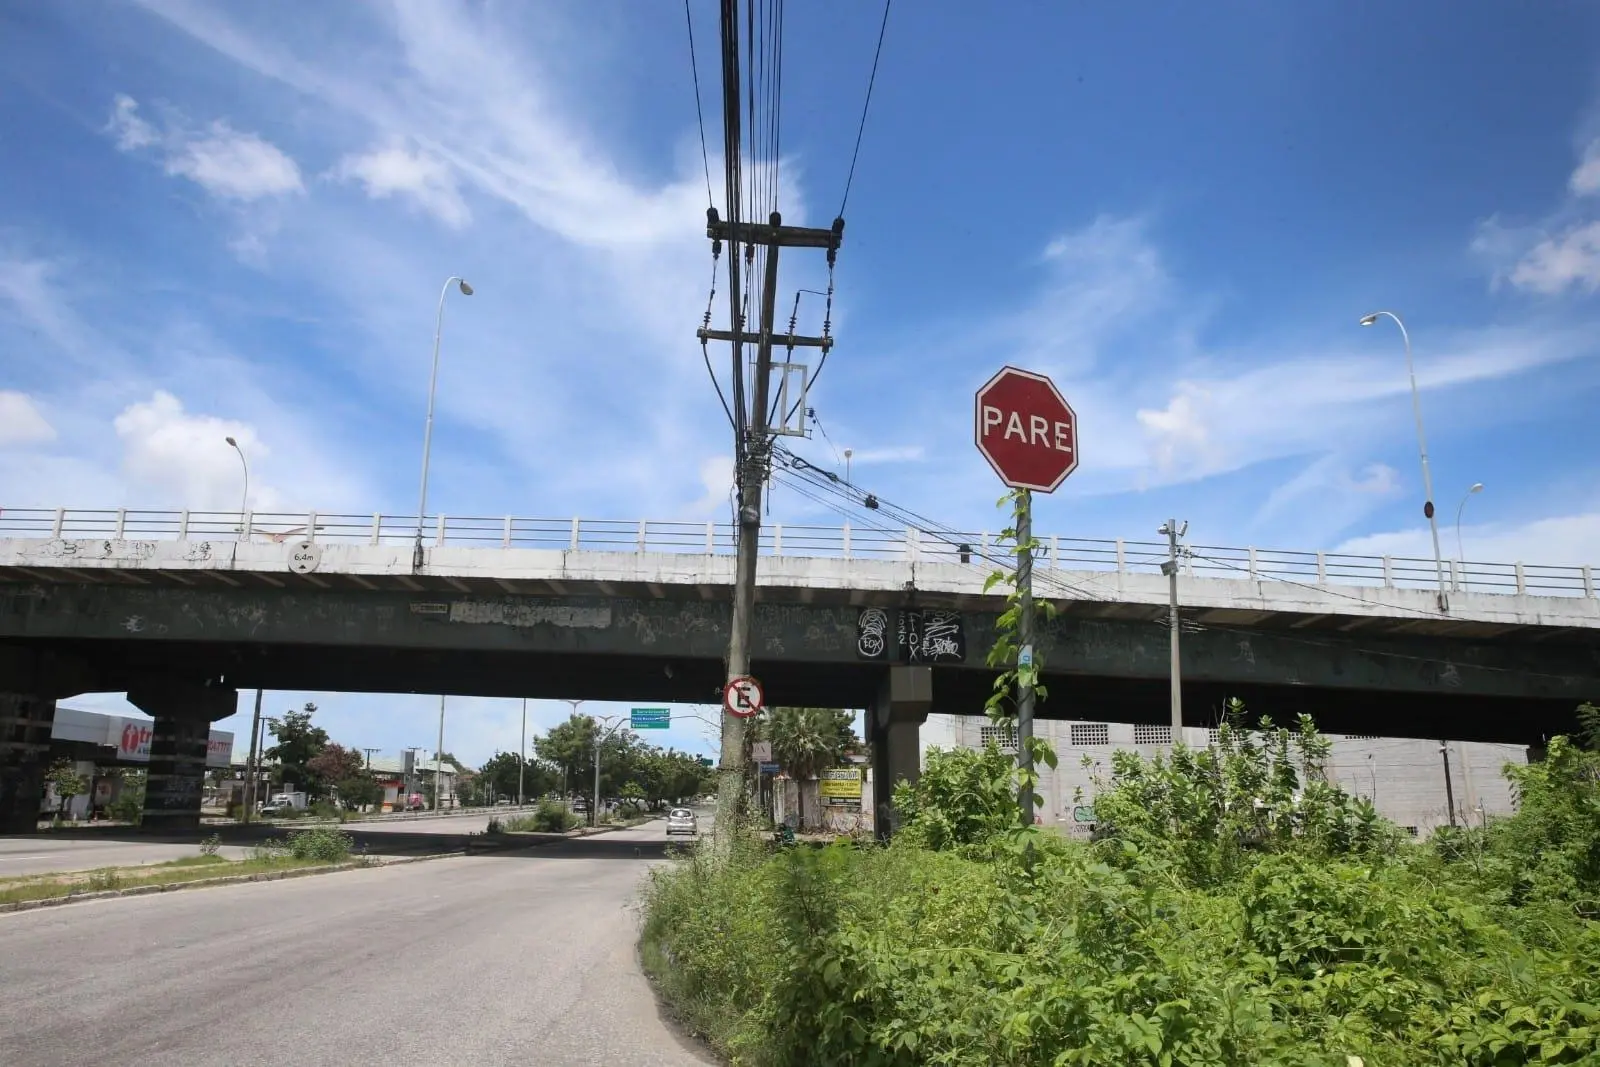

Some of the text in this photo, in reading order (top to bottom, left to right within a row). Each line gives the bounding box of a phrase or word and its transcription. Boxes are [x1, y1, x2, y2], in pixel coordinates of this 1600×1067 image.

[983, 405, 1072, 453] PARE
[863, 637, 881, 654] FOX
[737, 686, 751, 708] E
